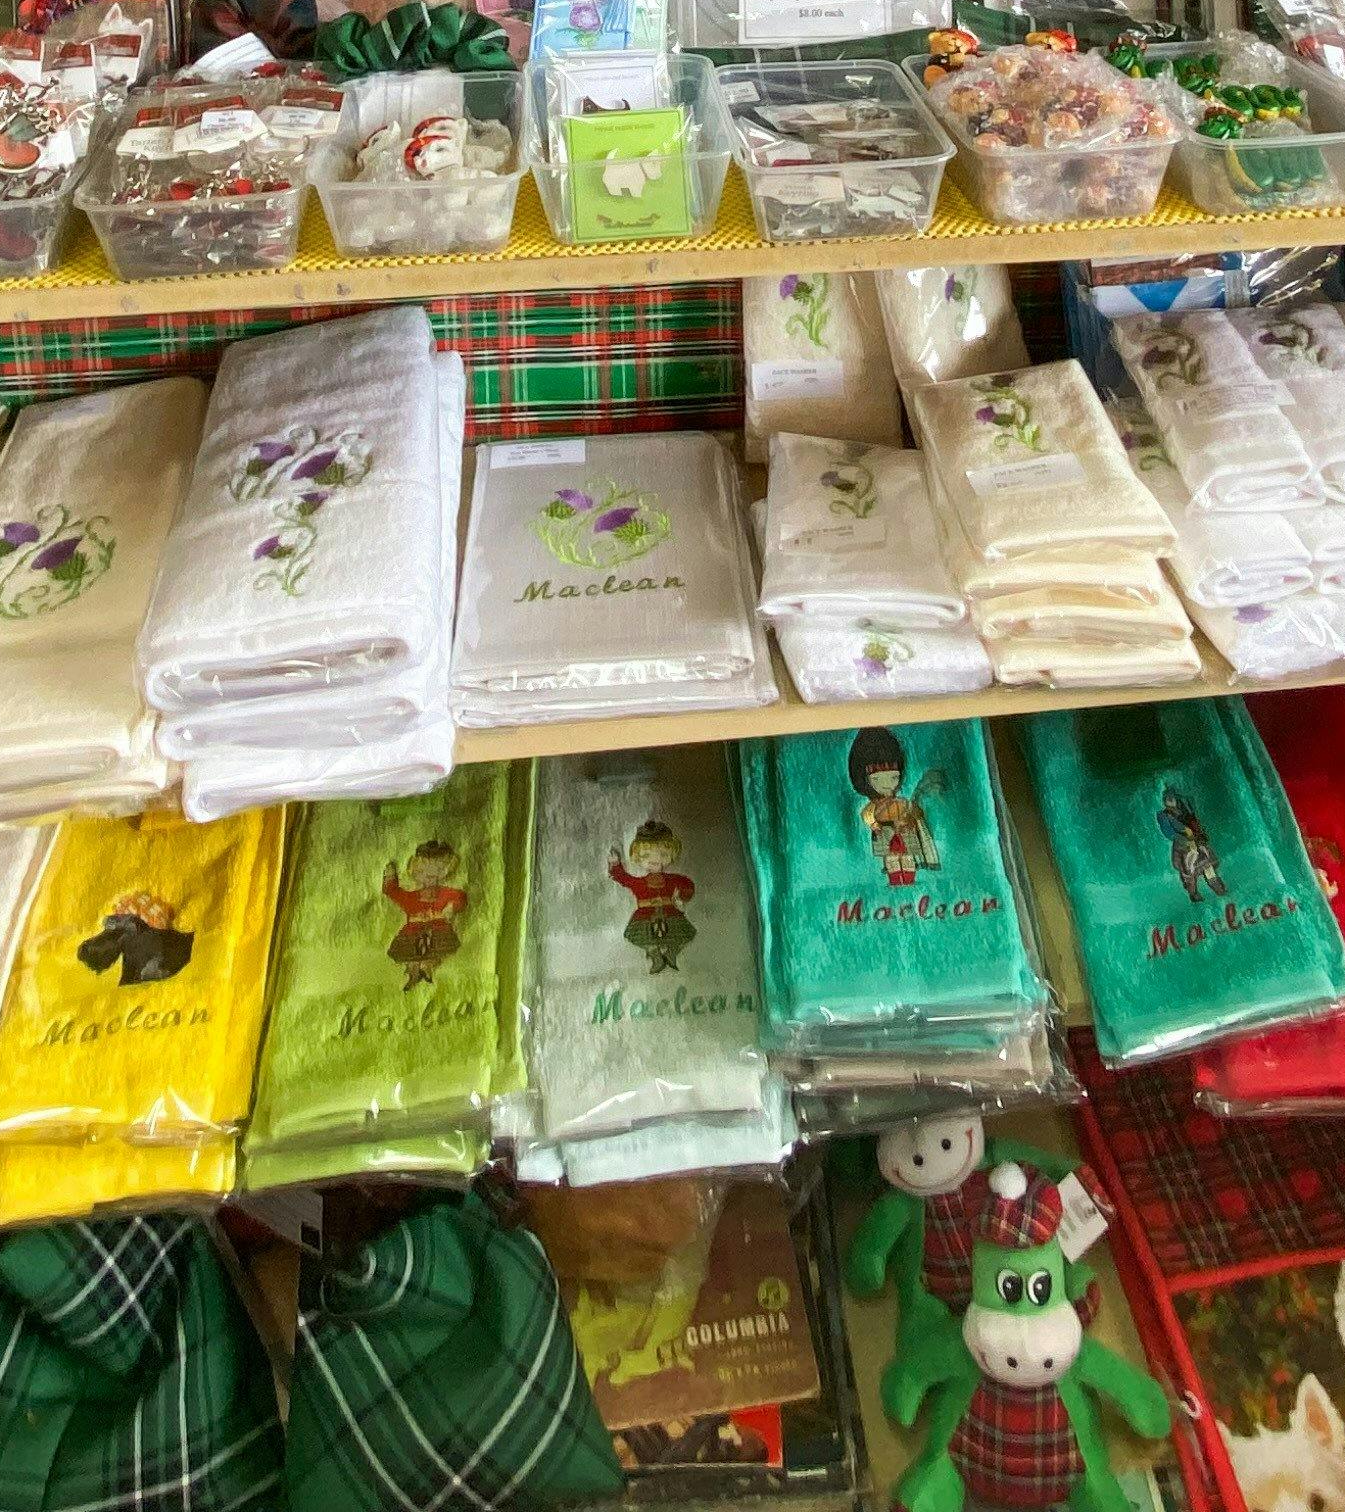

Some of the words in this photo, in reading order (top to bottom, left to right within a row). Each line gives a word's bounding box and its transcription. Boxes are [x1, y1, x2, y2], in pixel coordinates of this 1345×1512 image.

[823, 8, 845, 19] each
[513, 574, 686, 604] Maclean
[836, 893, 1004, 926] Maclean
[590, 986, 757, 1026] Maclean
[36, 1005, 213, 1048] Maclean
